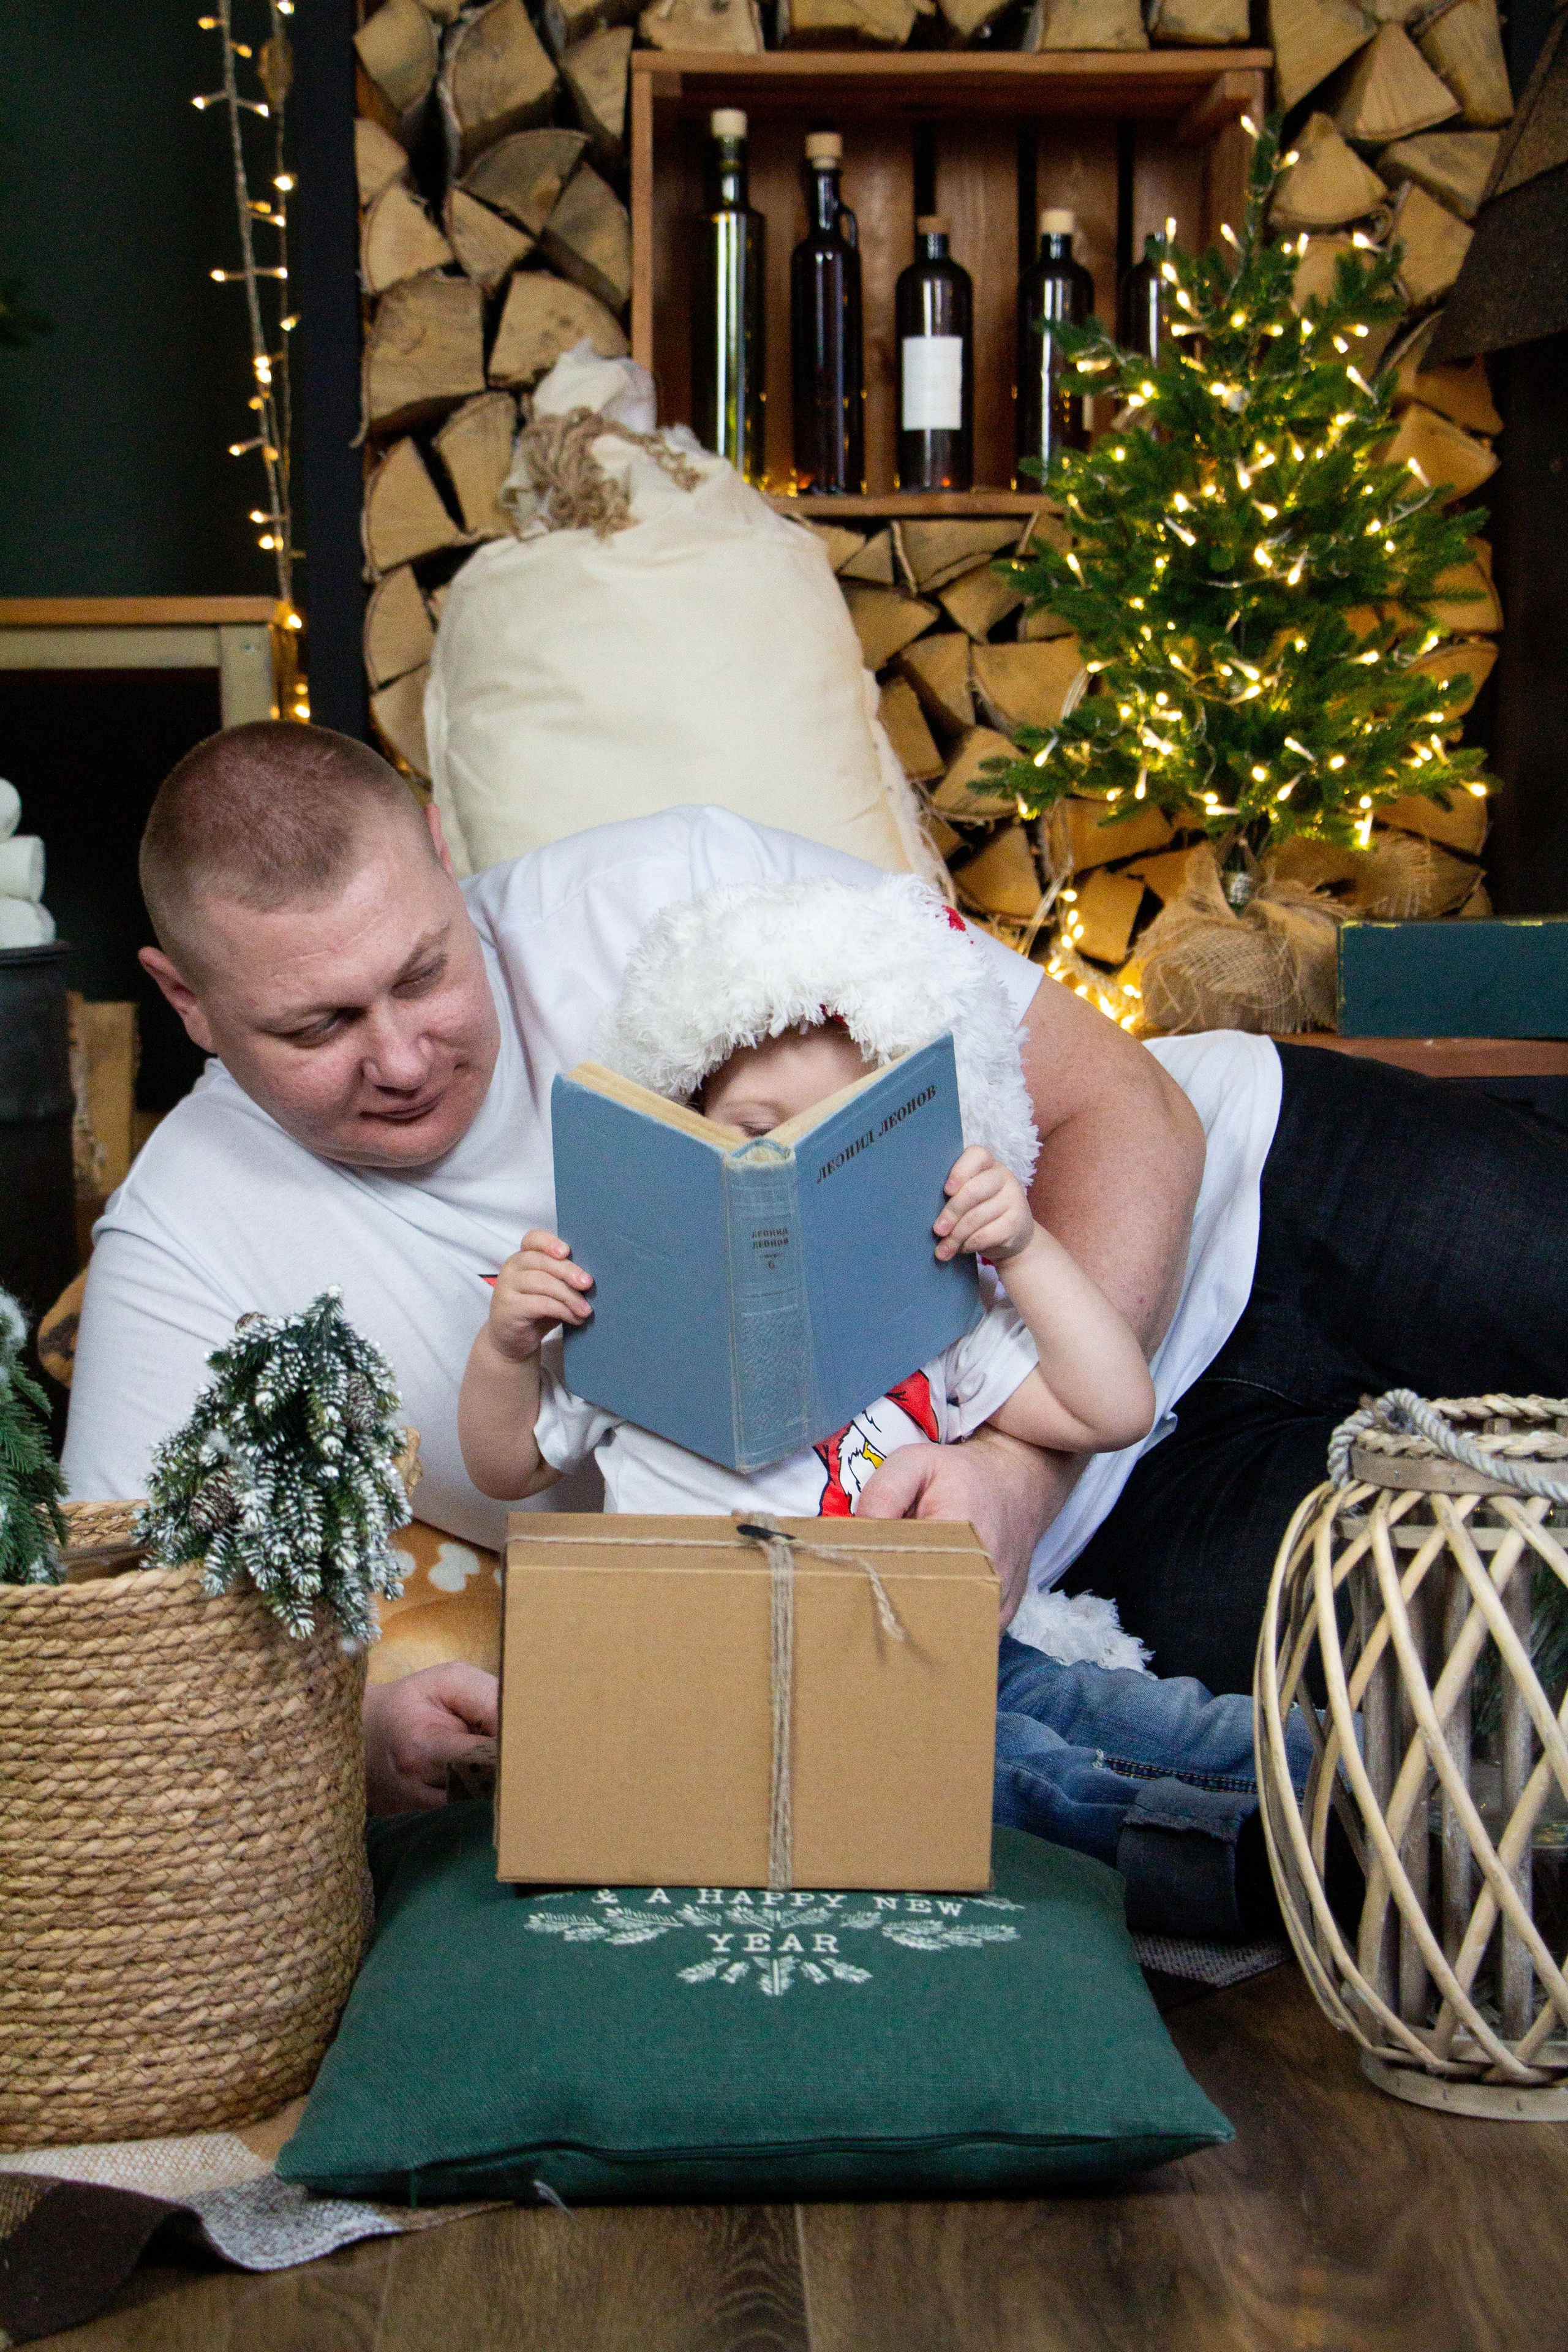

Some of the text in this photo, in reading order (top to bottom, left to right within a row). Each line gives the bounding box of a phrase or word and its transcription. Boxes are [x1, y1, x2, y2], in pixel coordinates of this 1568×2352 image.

[816, 1085, 937, 1185] ЛЕОНИД ЛЕОНОВ
[591, 1888, 964, 1917] & A HAPPY NEW
[706, 1932, 840, 1953] YEAR
